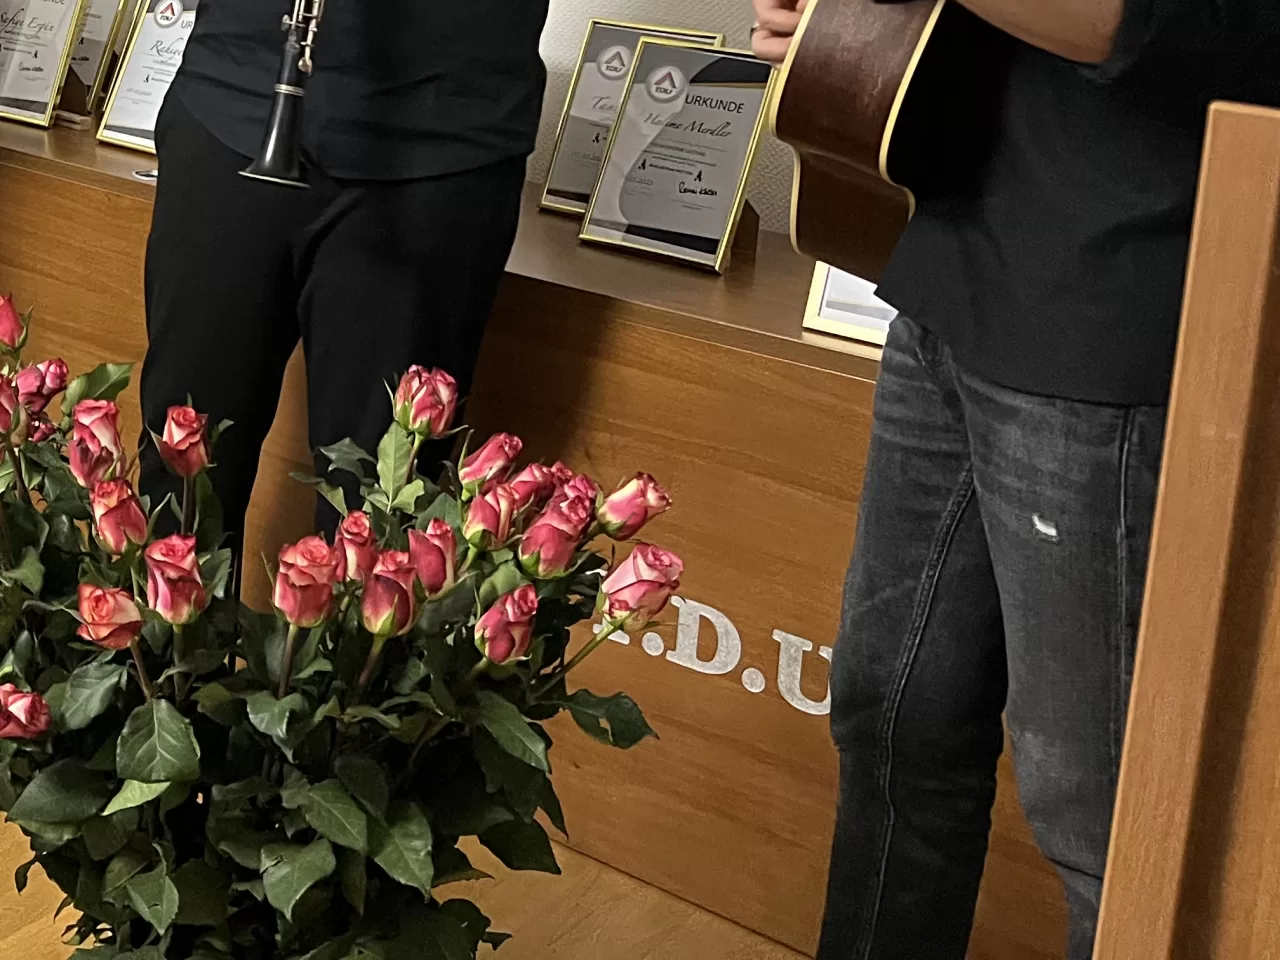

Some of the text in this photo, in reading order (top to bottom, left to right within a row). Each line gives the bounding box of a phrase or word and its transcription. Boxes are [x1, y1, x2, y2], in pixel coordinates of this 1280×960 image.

[159, 14, 173, 22] TDU
[605, 65, 622, 73] TDU
[654, 86, 673, 95] TDU
[685, 93, 745, 114] URKUNDE
[588, 572, 833, 716] .D.U
